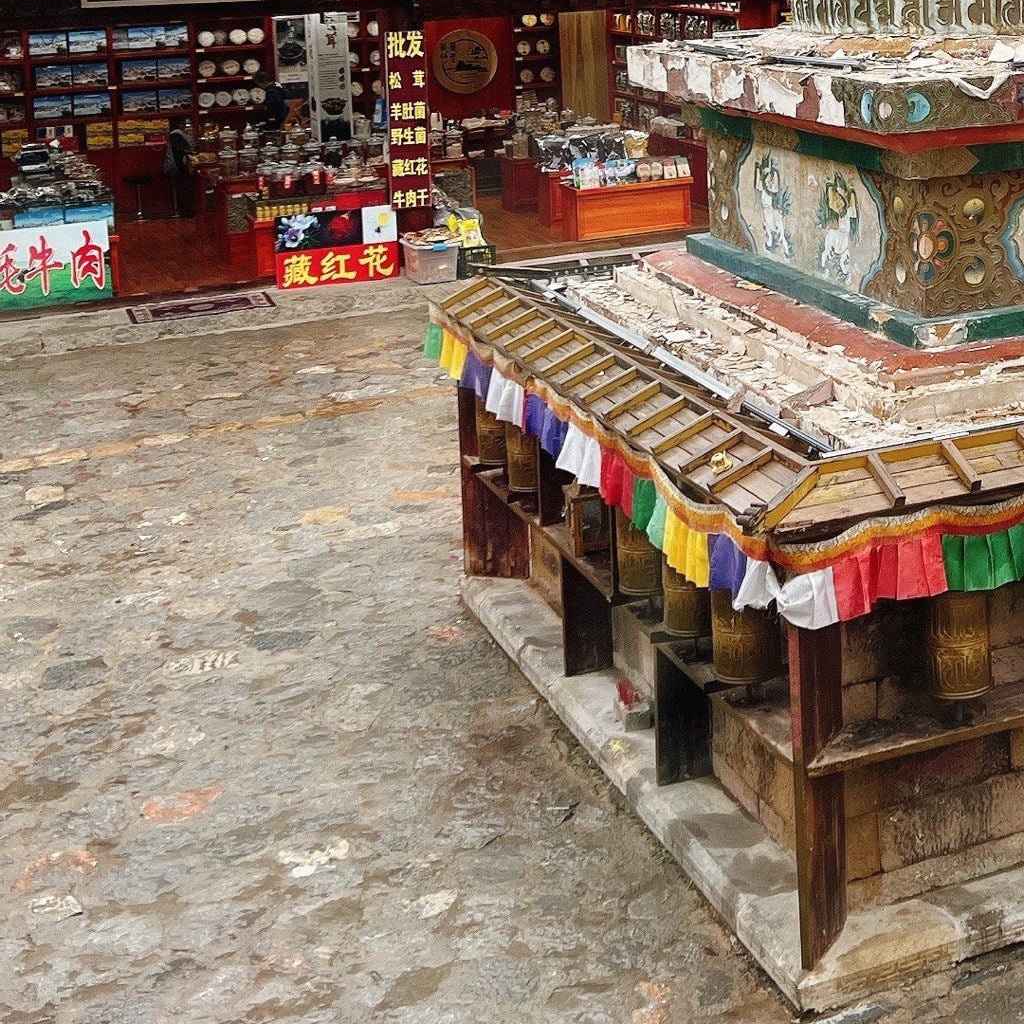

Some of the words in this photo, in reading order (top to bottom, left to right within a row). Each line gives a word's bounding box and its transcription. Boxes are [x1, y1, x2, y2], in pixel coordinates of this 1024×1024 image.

[387, 31, 425, 58] 批发
[389, 70, 426, 89] 松茸
[390, 101, 426, 121] 羊肚菌
[390, 126, 427, 146] 野生菌
[392, 157, 429, 177] 藏红花
[393, 188, 429, 208] 牛肉干
[282, 244, 395, 288] 藏红花
